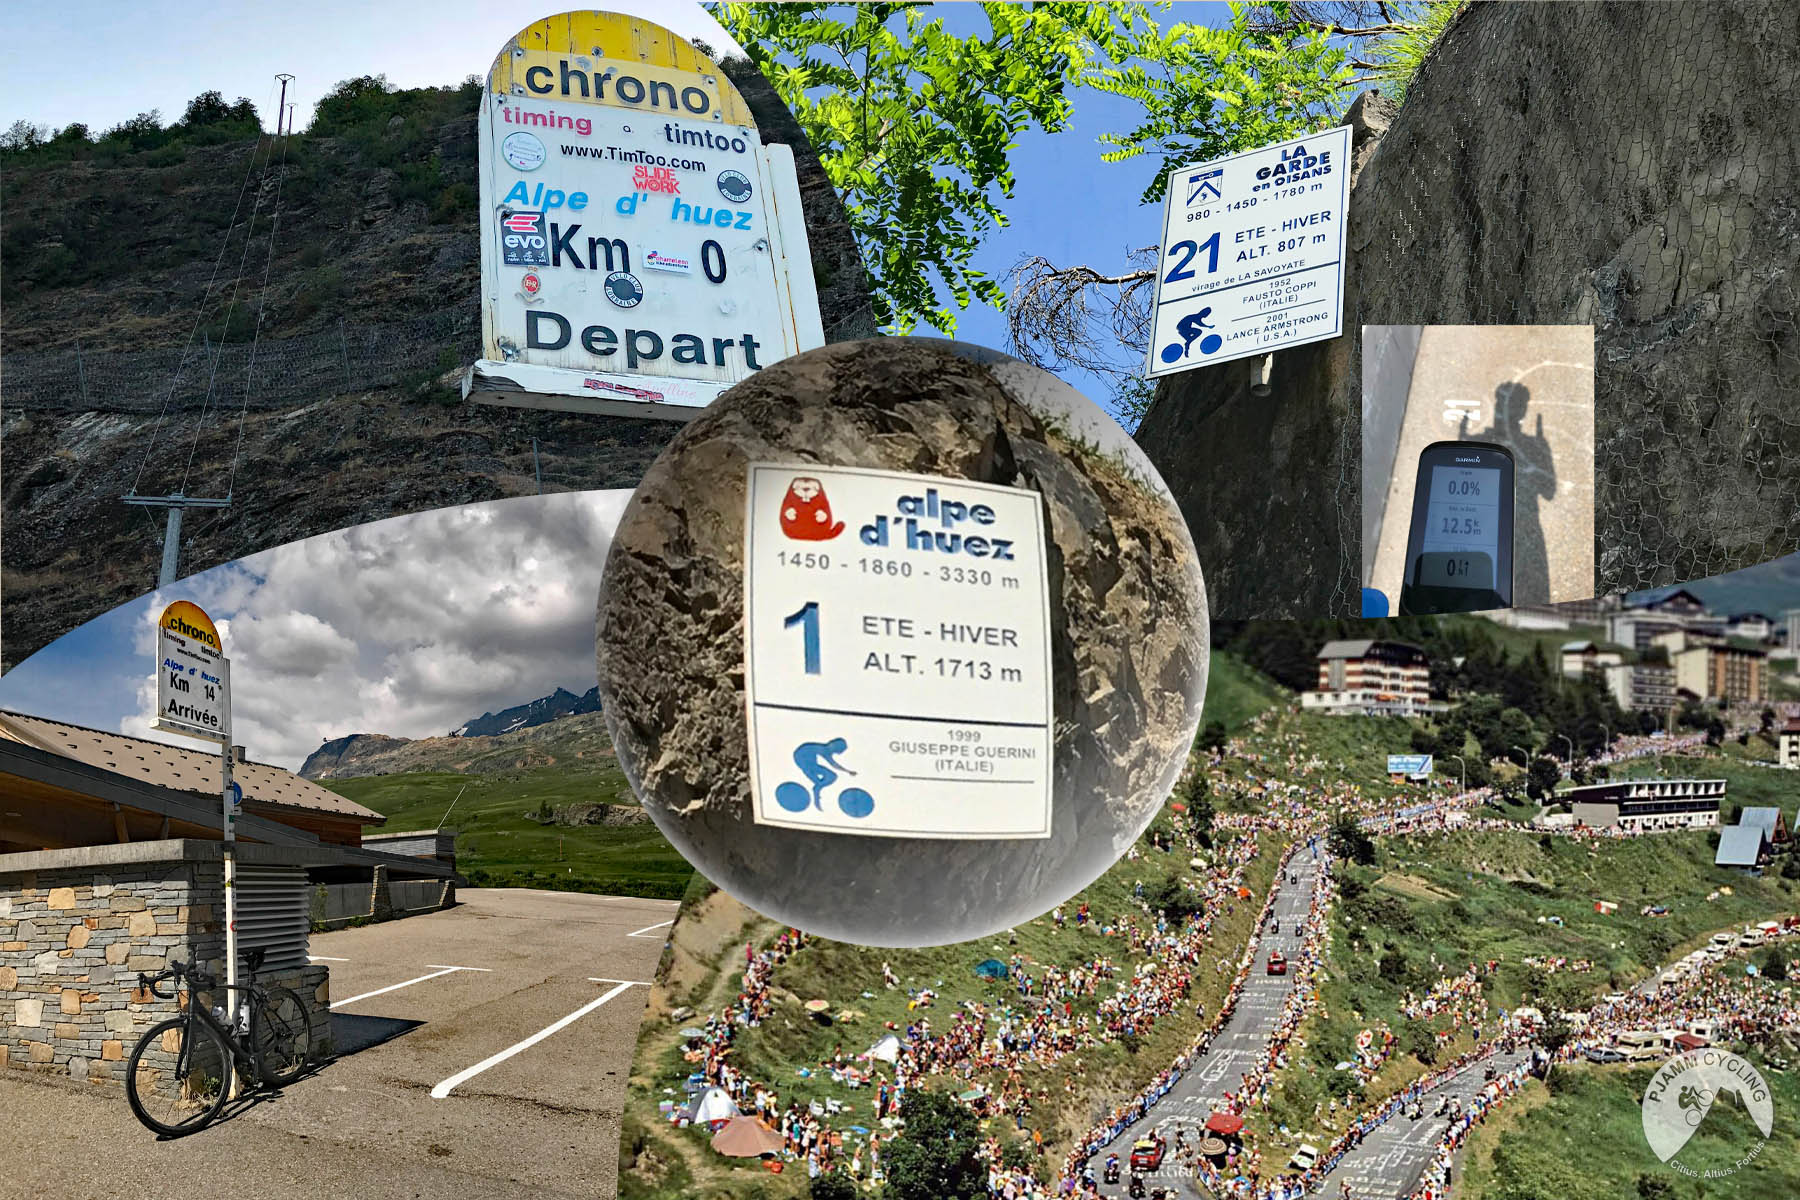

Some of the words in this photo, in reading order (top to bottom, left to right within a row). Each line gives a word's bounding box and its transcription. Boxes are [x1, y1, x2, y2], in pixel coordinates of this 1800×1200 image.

[525, 60, 710, 115] chrono
[502, 106, 593, 137] timing
[663, 122, 747, 154] timtoo
[560, 143, 706, 173] www.TimToo.com
[1255, 151, 1331, 181] GARDE
[1281, 145, 1307, 162] LA
[632, 176, 681, 195] WORK
[634, 165, 677, 182] SLIDE
[1252, 182, 1271, 193] en
[1274, 164, 1332, 187] OISANS
[503, 180, 589, 213] Alpe
[615, 192, 648, 216] d'
[671, 198, 753, 231] huez
[1186, 209, 1211, 223] 980
[1226, 197, 1258, 213] 1450
[1274, 184, 1306, 201] 1780
[1310, 182, 1323, 192] m
[1235, 226, 1266, 243] ETE
[1282, 210, 1332, 232] HIVER
[504, 234, 546, 249] evo
[549, 223, 631, 272] Km
[701, 239, 727, 284] 0
[1236, 245, 1271, 262] ALT.
[1277, 236, 1307, 253] 807
[1312, 233, 1326, 244] m
[1163, 232, 1221, 284] 21
[1191, 281, 1221, 293] virage
[1223, 276, 1235, 285] de
[1238, 272, 1251, 281] LA
[1253, 259, 1306, 278] SAVOYATE
[1269, 278, 1292, 289] 1952
[1242, 289, 1283, 304] FAUSTO
[1285, 280, 1317, 294] COPPI
[1259, 294, 1299, 310] (ITALIE)
[1226, 327, 1260, 341] LANCE
[1263, 312, 1329, 333] ARMSTRONG
[1266, 312, 1289, 323] 2001
[526, 310, 763, 371] Depart
[1448, 480, 1481, 497] 0.0%
[896, 488, 996, 528] alpe
[859, 515, 1015, 562] d'huez
[777, 551, 830, 570] 1450
[858, 558, 912, 577] 1860
[940, 566, 992, 587] 3330
[1002, 575, 1019, 590] m
[163, 629, 186, 648] timing
[169, 616, 214, 645] chrono
[784, 601, 822, 675] 1
[862, 615, 914, 639] ETE
[940, 623, 1018, 648] HIVER
[163, 658, 184, 672] Alpe
[188, 668, 198, 677] d'
[201, 671, 220, 685] huez
[863, 652, 924, 675] ALT.
[934, 658, 992, 681] 1713
[1000, 666, 1022, 683] m
[170, 671, 190, 693] Km
[204, 684, 216, 701] 14
[167, 698, 218, 727] Arrivée
[888, 741, 969, 757] GIUSEPPE
[974, 746, 1036, 759] GUERINI
[946, 729, 981, 742] 1999
[935, 759, 994, 774] (ITALIE)
